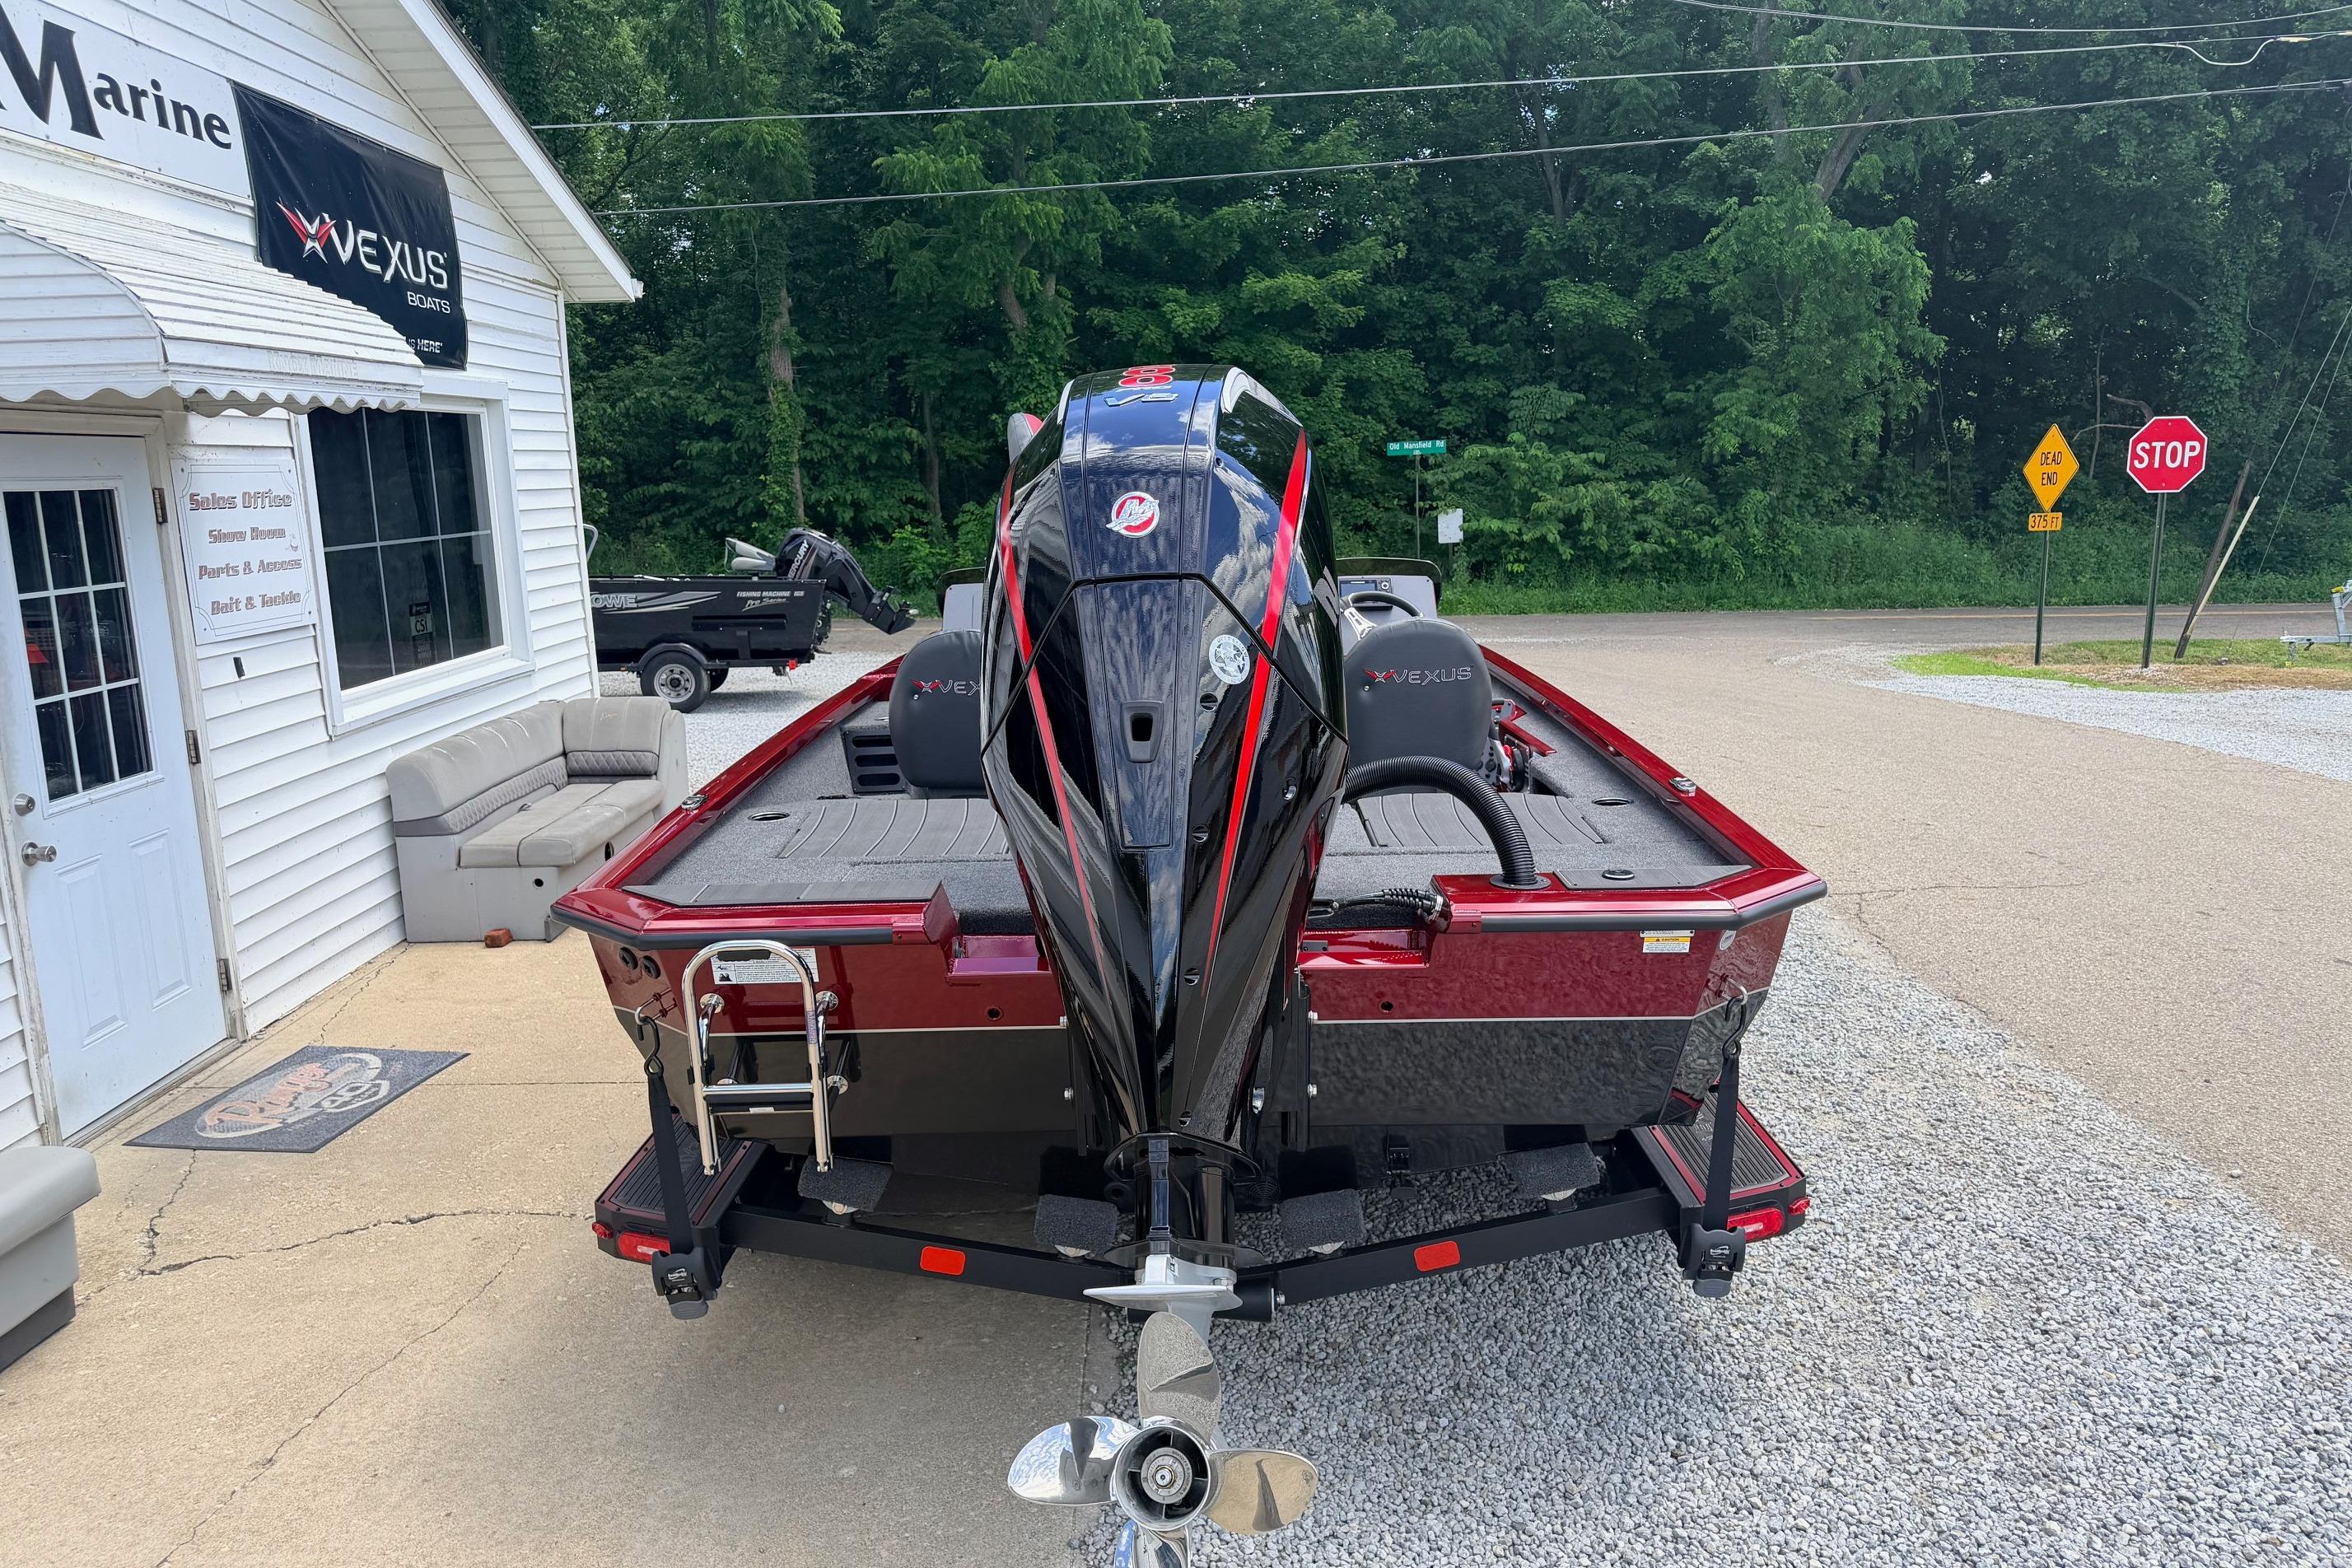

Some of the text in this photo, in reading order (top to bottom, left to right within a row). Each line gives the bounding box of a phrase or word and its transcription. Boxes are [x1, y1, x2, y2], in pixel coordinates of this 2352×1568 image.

[0, 1, 232, 150] Marine
[322, 212, 449, 291] VEXUS
[407, 292, 451, 314] BOATS
[1389, 440, 1444, 450] Old Mansfield Rd
[2041, 451, 2063, 466] DEAD
[2134, 441, 2201, 469] STOP
[2042, 472, 2058, 486] END
[189, 488, 292, 511] Sales Office
[2031, 515, 2060, 529] 375 FT
[208, 526, 287, 544] Show Room
[198, 558, 302, 580] Parts & Access
[211, 590, 301, 615] Bait & Tackle
[590, 594, 637, 609] OWE
[744, 600, 761, 608] Pro
[1390, 667, 1472, 686] VEXUS
[936, 679, 981, 696] VEX
